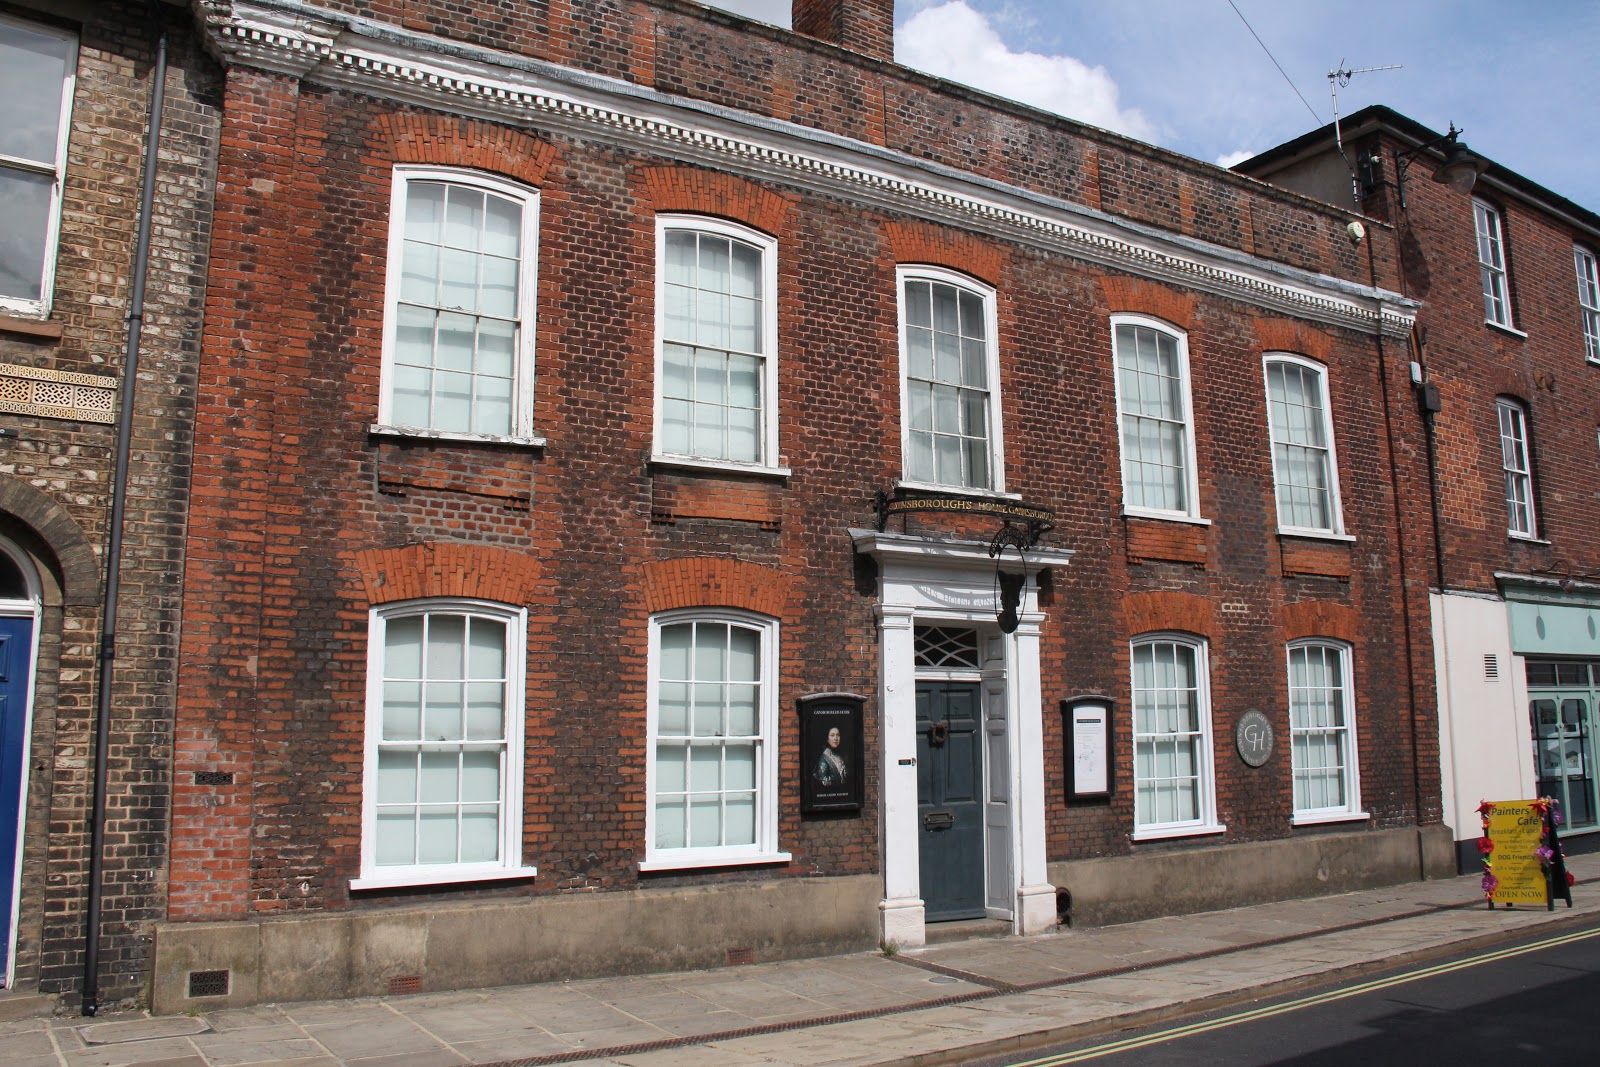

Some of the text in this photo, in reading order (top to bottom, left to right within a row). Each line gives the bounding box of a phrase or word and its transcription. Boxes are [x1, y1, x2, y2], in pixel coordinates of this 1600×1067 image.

[978, 502, 1008, 514] HOUSE
[1491, 807, 1530, 815] Painters
[1495, 890, 1542, 898] OPEN NOW
